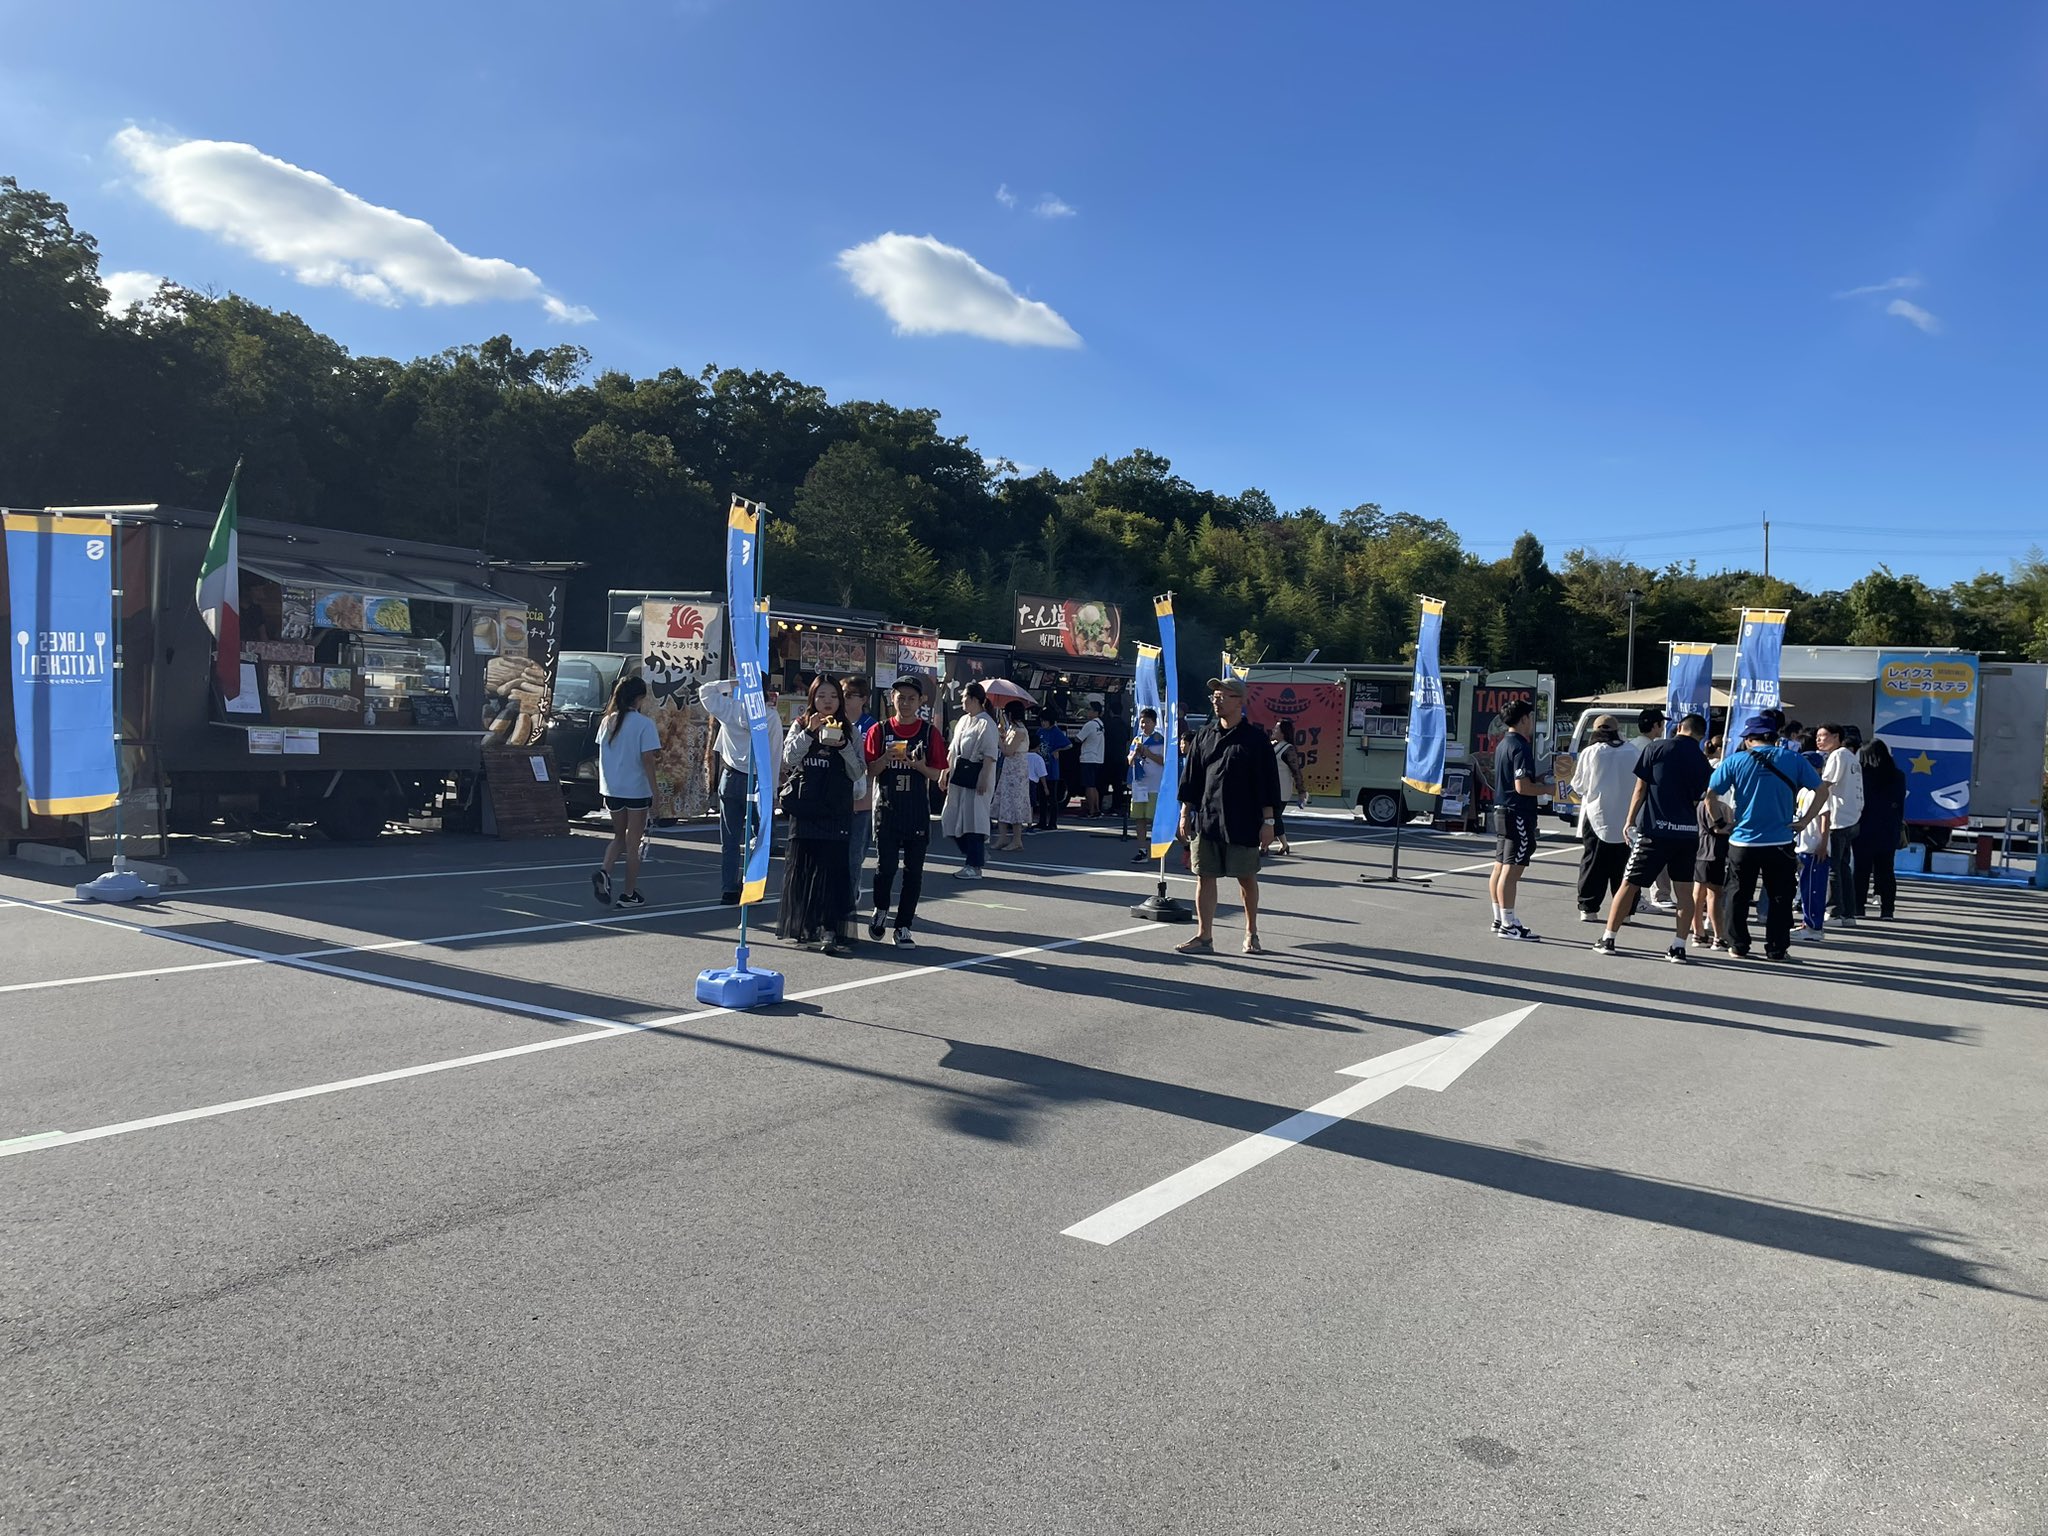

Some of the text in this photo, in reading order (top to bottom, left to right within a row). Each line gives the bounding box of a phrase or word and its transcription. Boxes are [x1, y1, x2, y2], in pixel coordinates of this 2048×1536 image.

[1018, 603, 1067, 629] たん塩
[1039, 632, 1064, 648] 専門店
[644, 650, 719, 676] からあげ
[1888, 667, 1933, 678] レイクス
[1886, 681, 1968, 692] ベビーカステラ
[895, 774, 912, 792] 31
